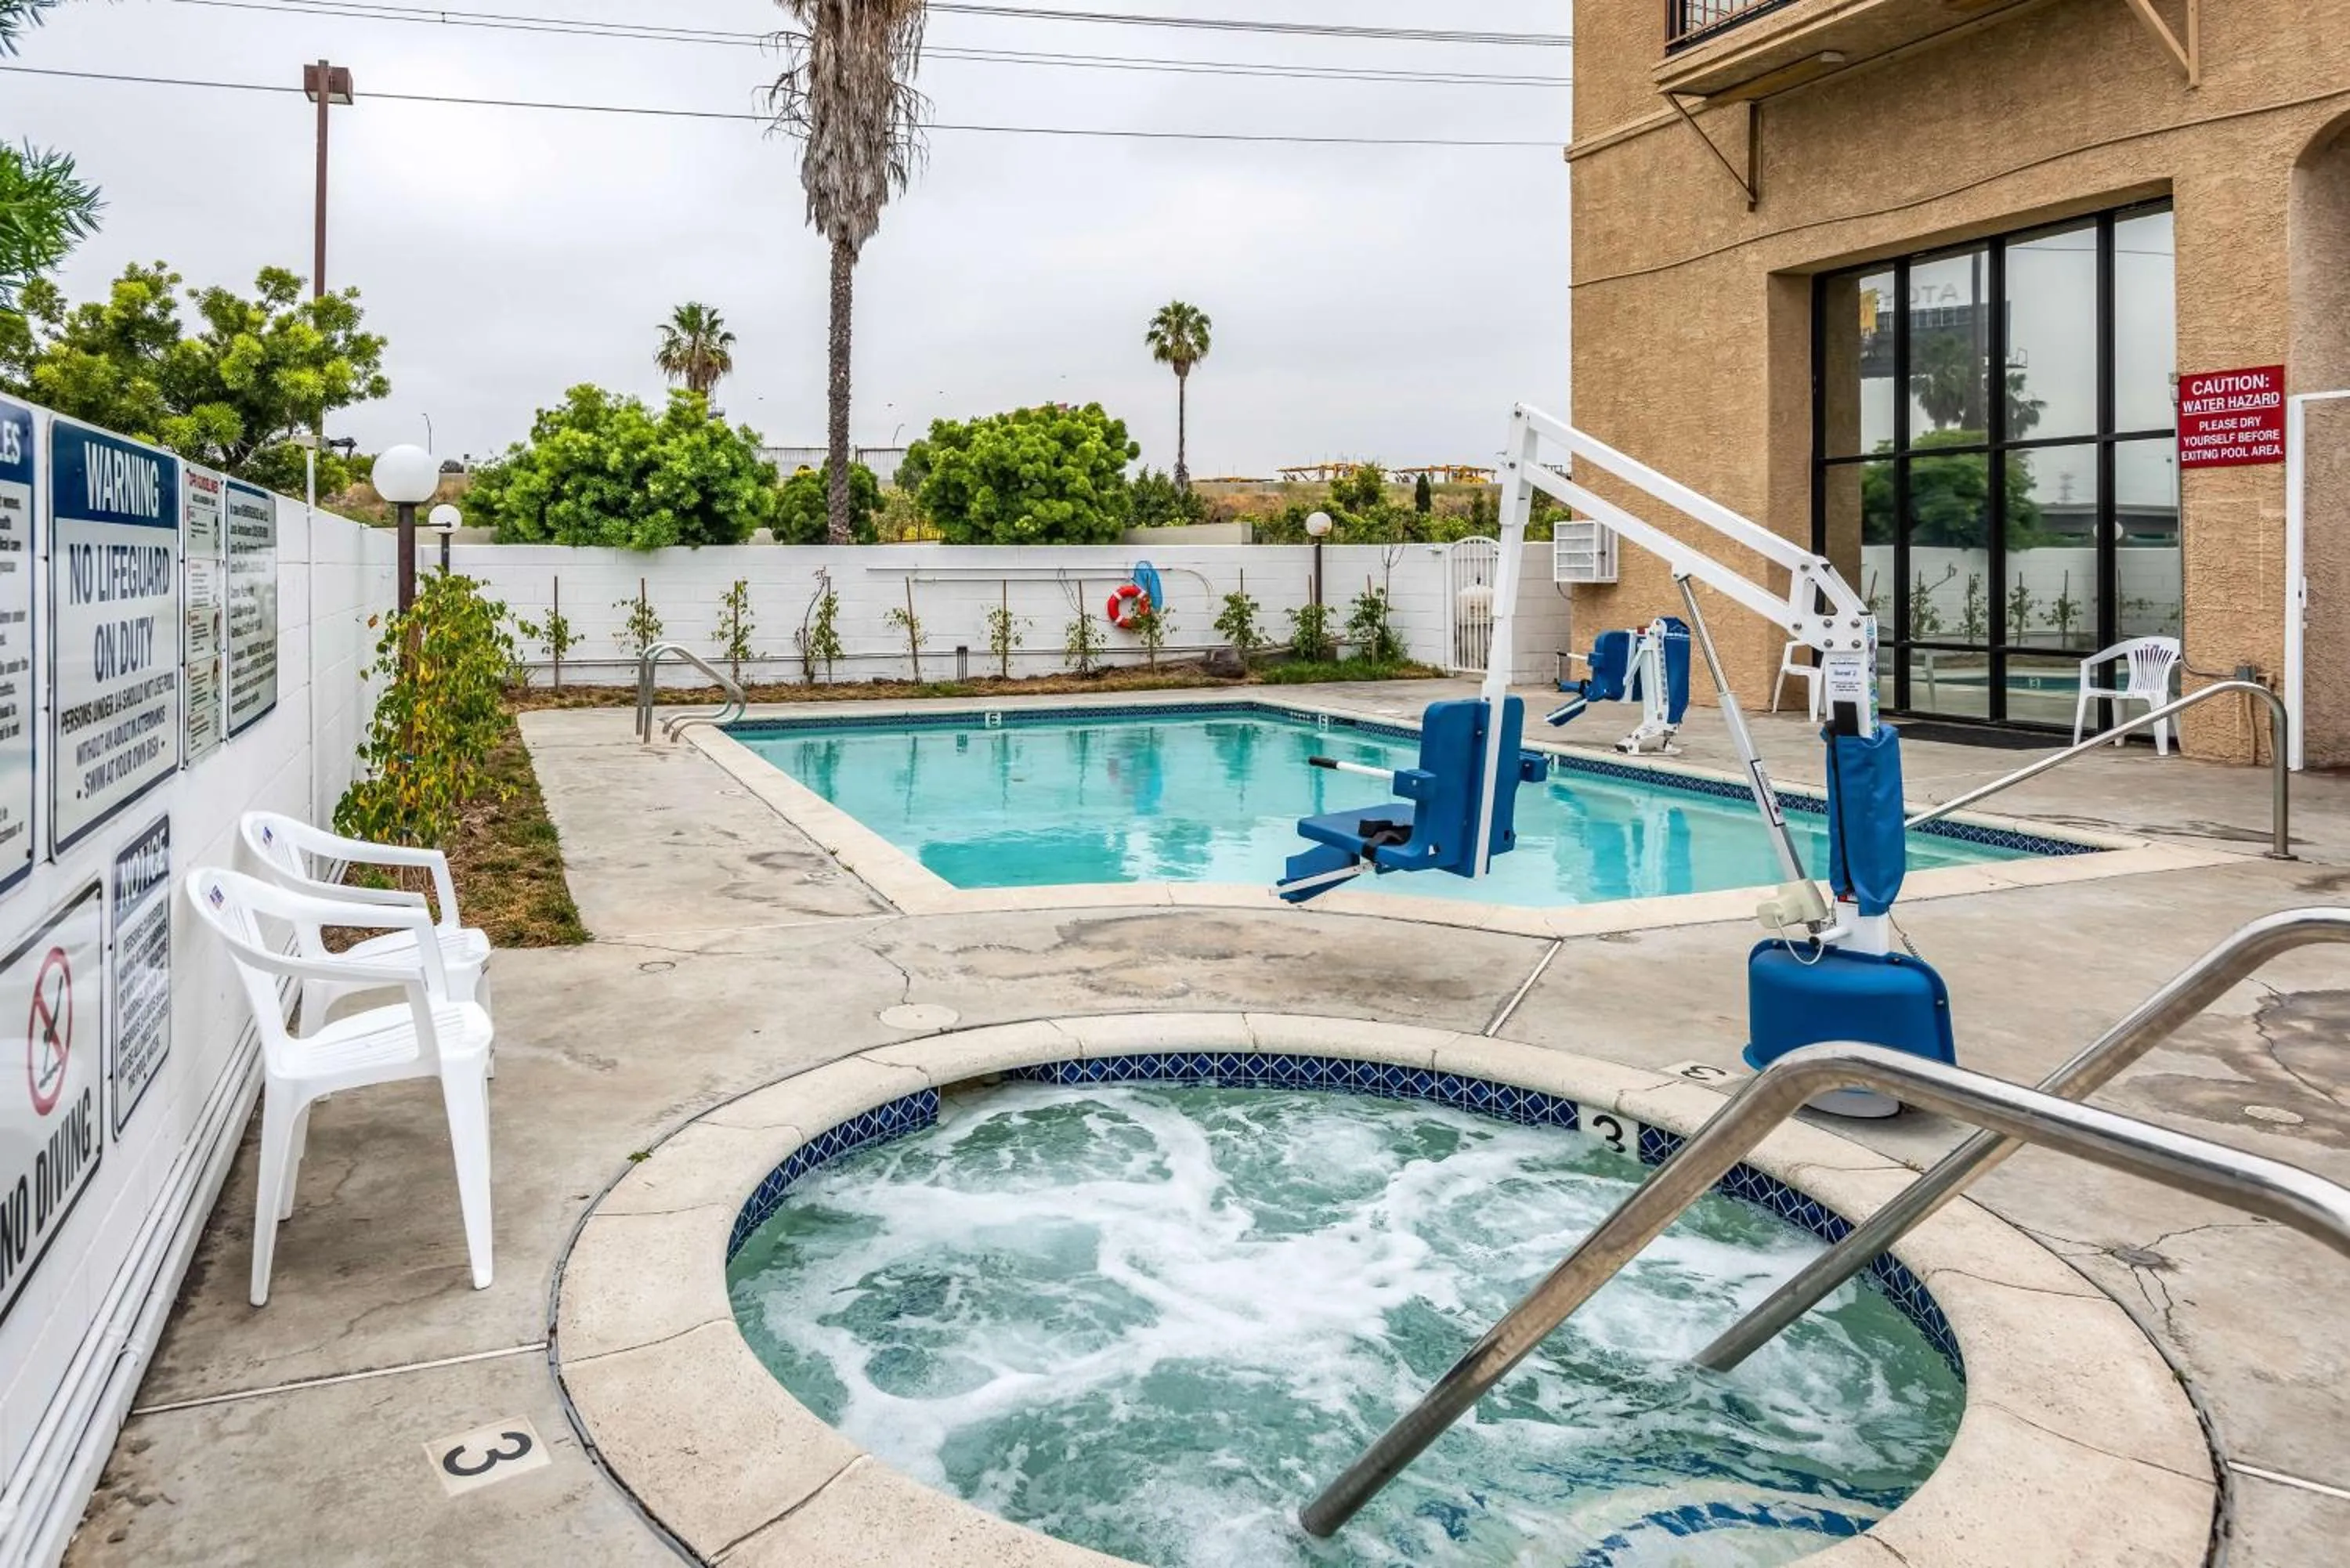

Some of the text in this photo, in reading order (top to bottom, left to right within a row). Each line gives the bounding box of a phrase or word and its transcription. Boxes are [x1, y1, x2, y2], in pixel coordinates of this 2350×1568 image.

[2182, 392, 2280, 414] WATER HAZARD
[2191, 374, 2270, 396] CAUTION:
[2183, 429, 2280, 447] YOURSELF BEFORE
[2199, 416, 2262, 432] PLEASE DRY
[2181, 445, 2283, 462] EXITING POOL AREA.
[84, 441, 159, 518] WARNING
[69, 543, 92, 606] NO
[97, 544, 170, 602] LIFEGUARD
[95, 623, 115, 683] ON
[120, 614, 154, 676] DUTY
[61, 702, 92, 737] PERSONS
[93, 693, 114, 722] UNDER
[84, 763, 106, 799] SWIM
[107, 758, 115, 786] AT
[115, 750, 132, 781] YOUR
[133, 742, 146, 770] OWN
[120, 828, 165, 913] NOTICE
[0, 1086, 92, 1292] NO DIVING
[443, 1431, 533, 1476] 3
